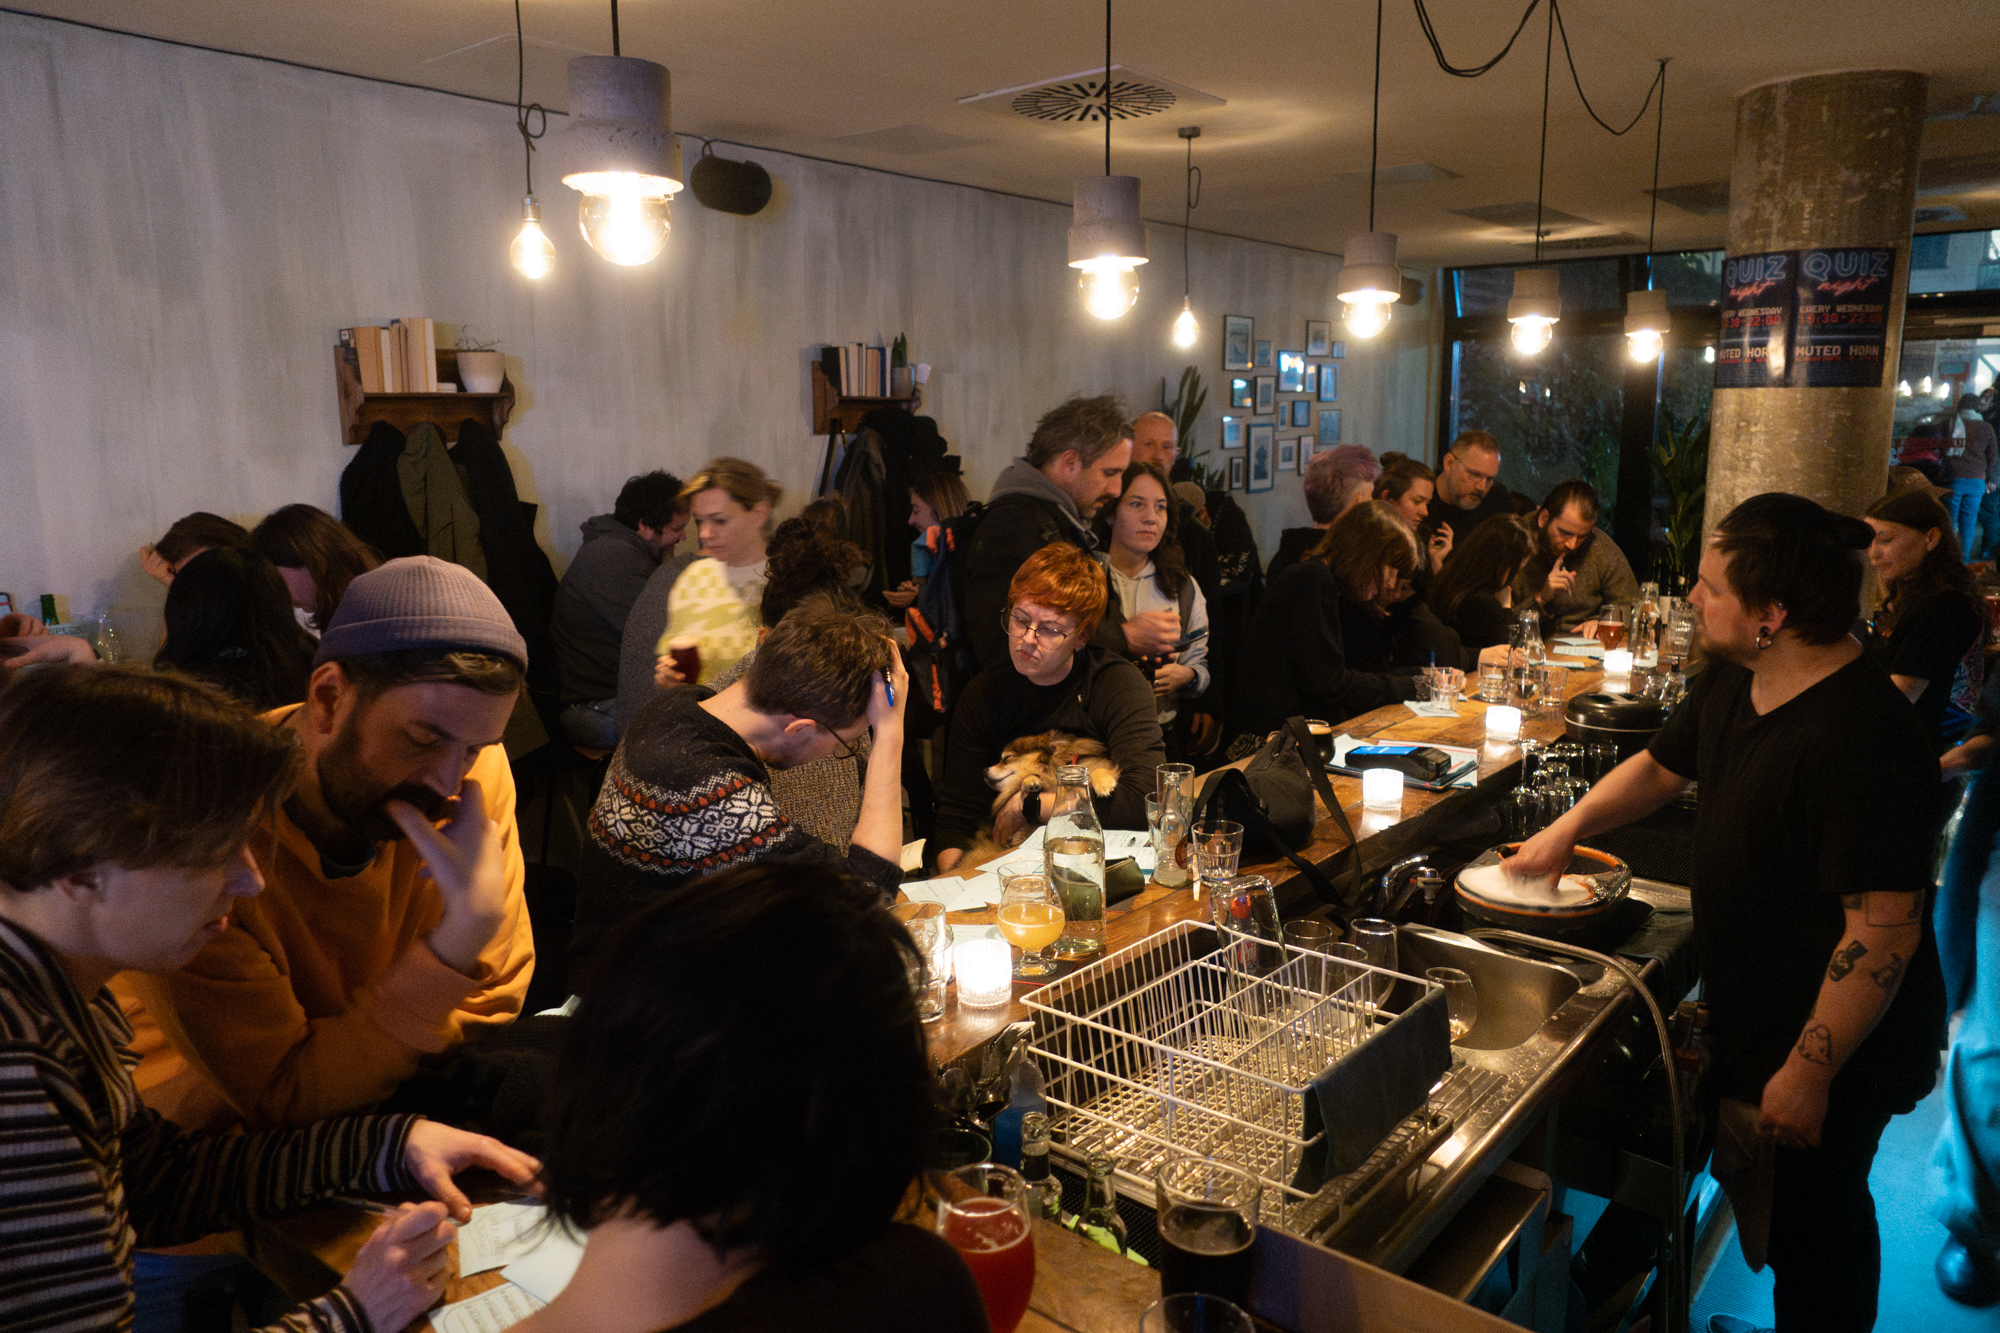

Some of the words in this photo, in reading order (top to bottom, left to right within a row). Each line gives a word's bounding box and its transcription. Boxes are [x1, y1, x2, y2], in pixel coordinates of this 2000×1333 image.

[1726, 255, 1787, 289] QUIZ
[1804, 252, 1889, 282] QUIZ
[1738, 307, 1782, 317] WEDNESDAY
[1799, 305, 1831, 313] EVERY
[1747, 347, 1768, 358] HOR
[1795, 345, 1841, 357] MUTED
[1849, 344, 1879, 356] HORN
